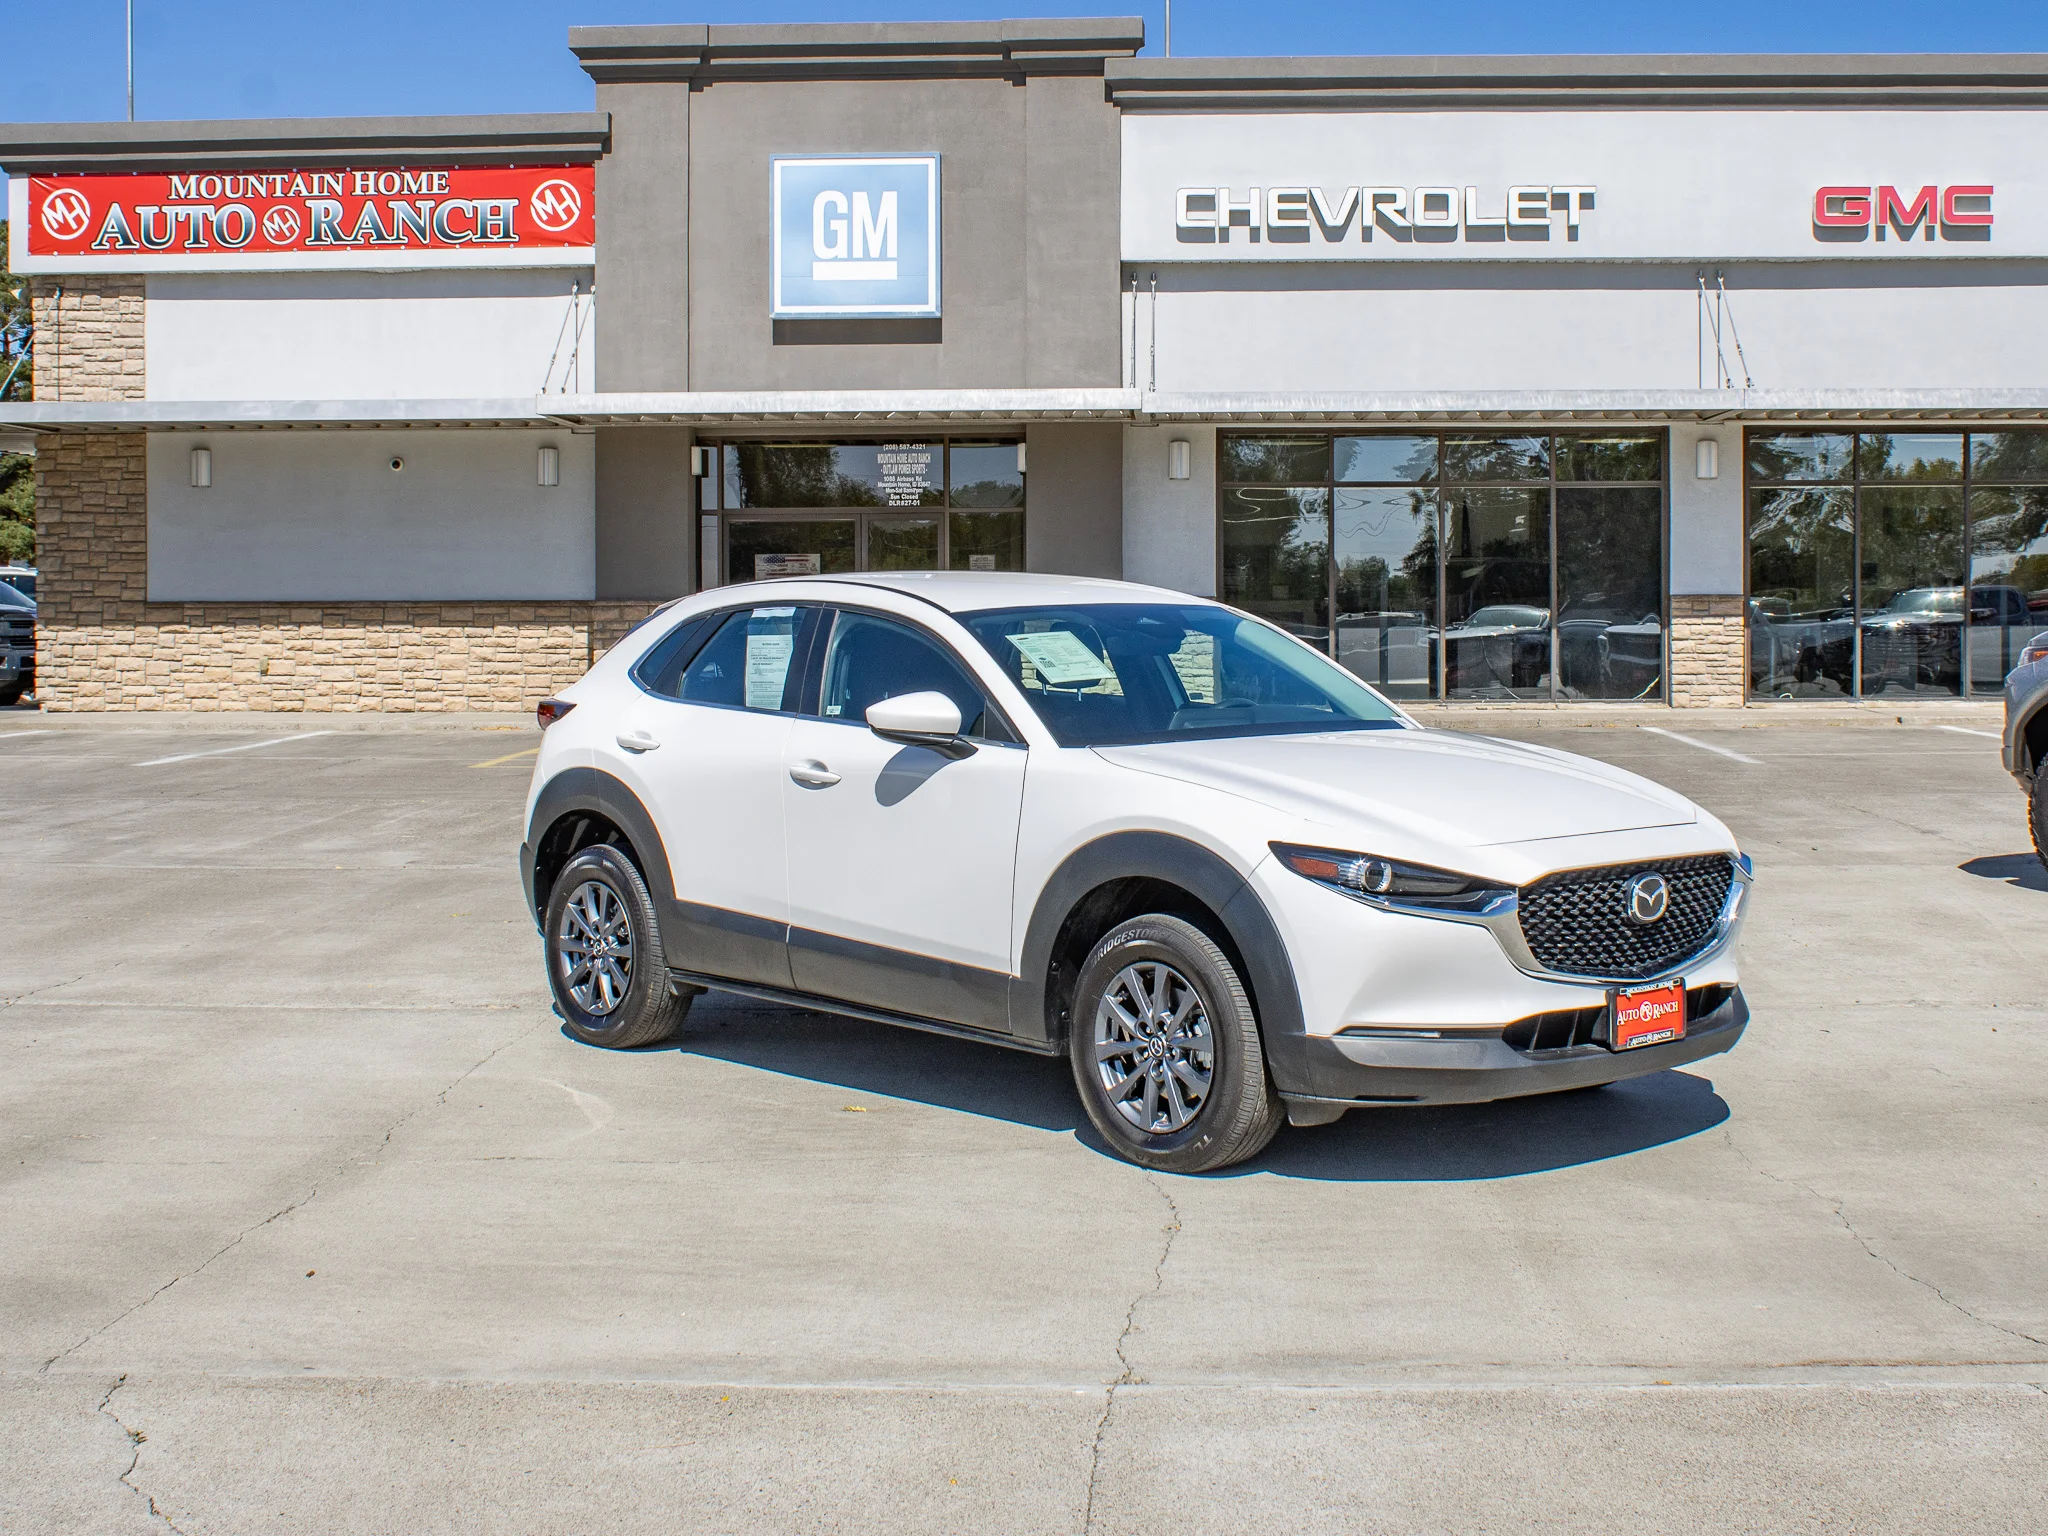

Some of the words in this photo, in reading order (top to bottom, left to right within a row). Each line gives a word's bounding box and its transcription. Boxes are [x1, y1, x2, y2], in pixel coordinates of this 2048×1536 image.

[168, 172, 345, 200] MOUNTAIN
[351, 170, 450, 197] HOME
[1814, 185, 1994, 227] GMC
[90, 202, 257, 250] AUTO
[304, 198, 520, 246] RANCH
[812, 190, 898, 260] GM
[1176, 186, 1598, 229] CHEVROLET
[1616, 1008, 1639, 1026] AUTO
[1653, 1000, 1679, 1019] RANCH
